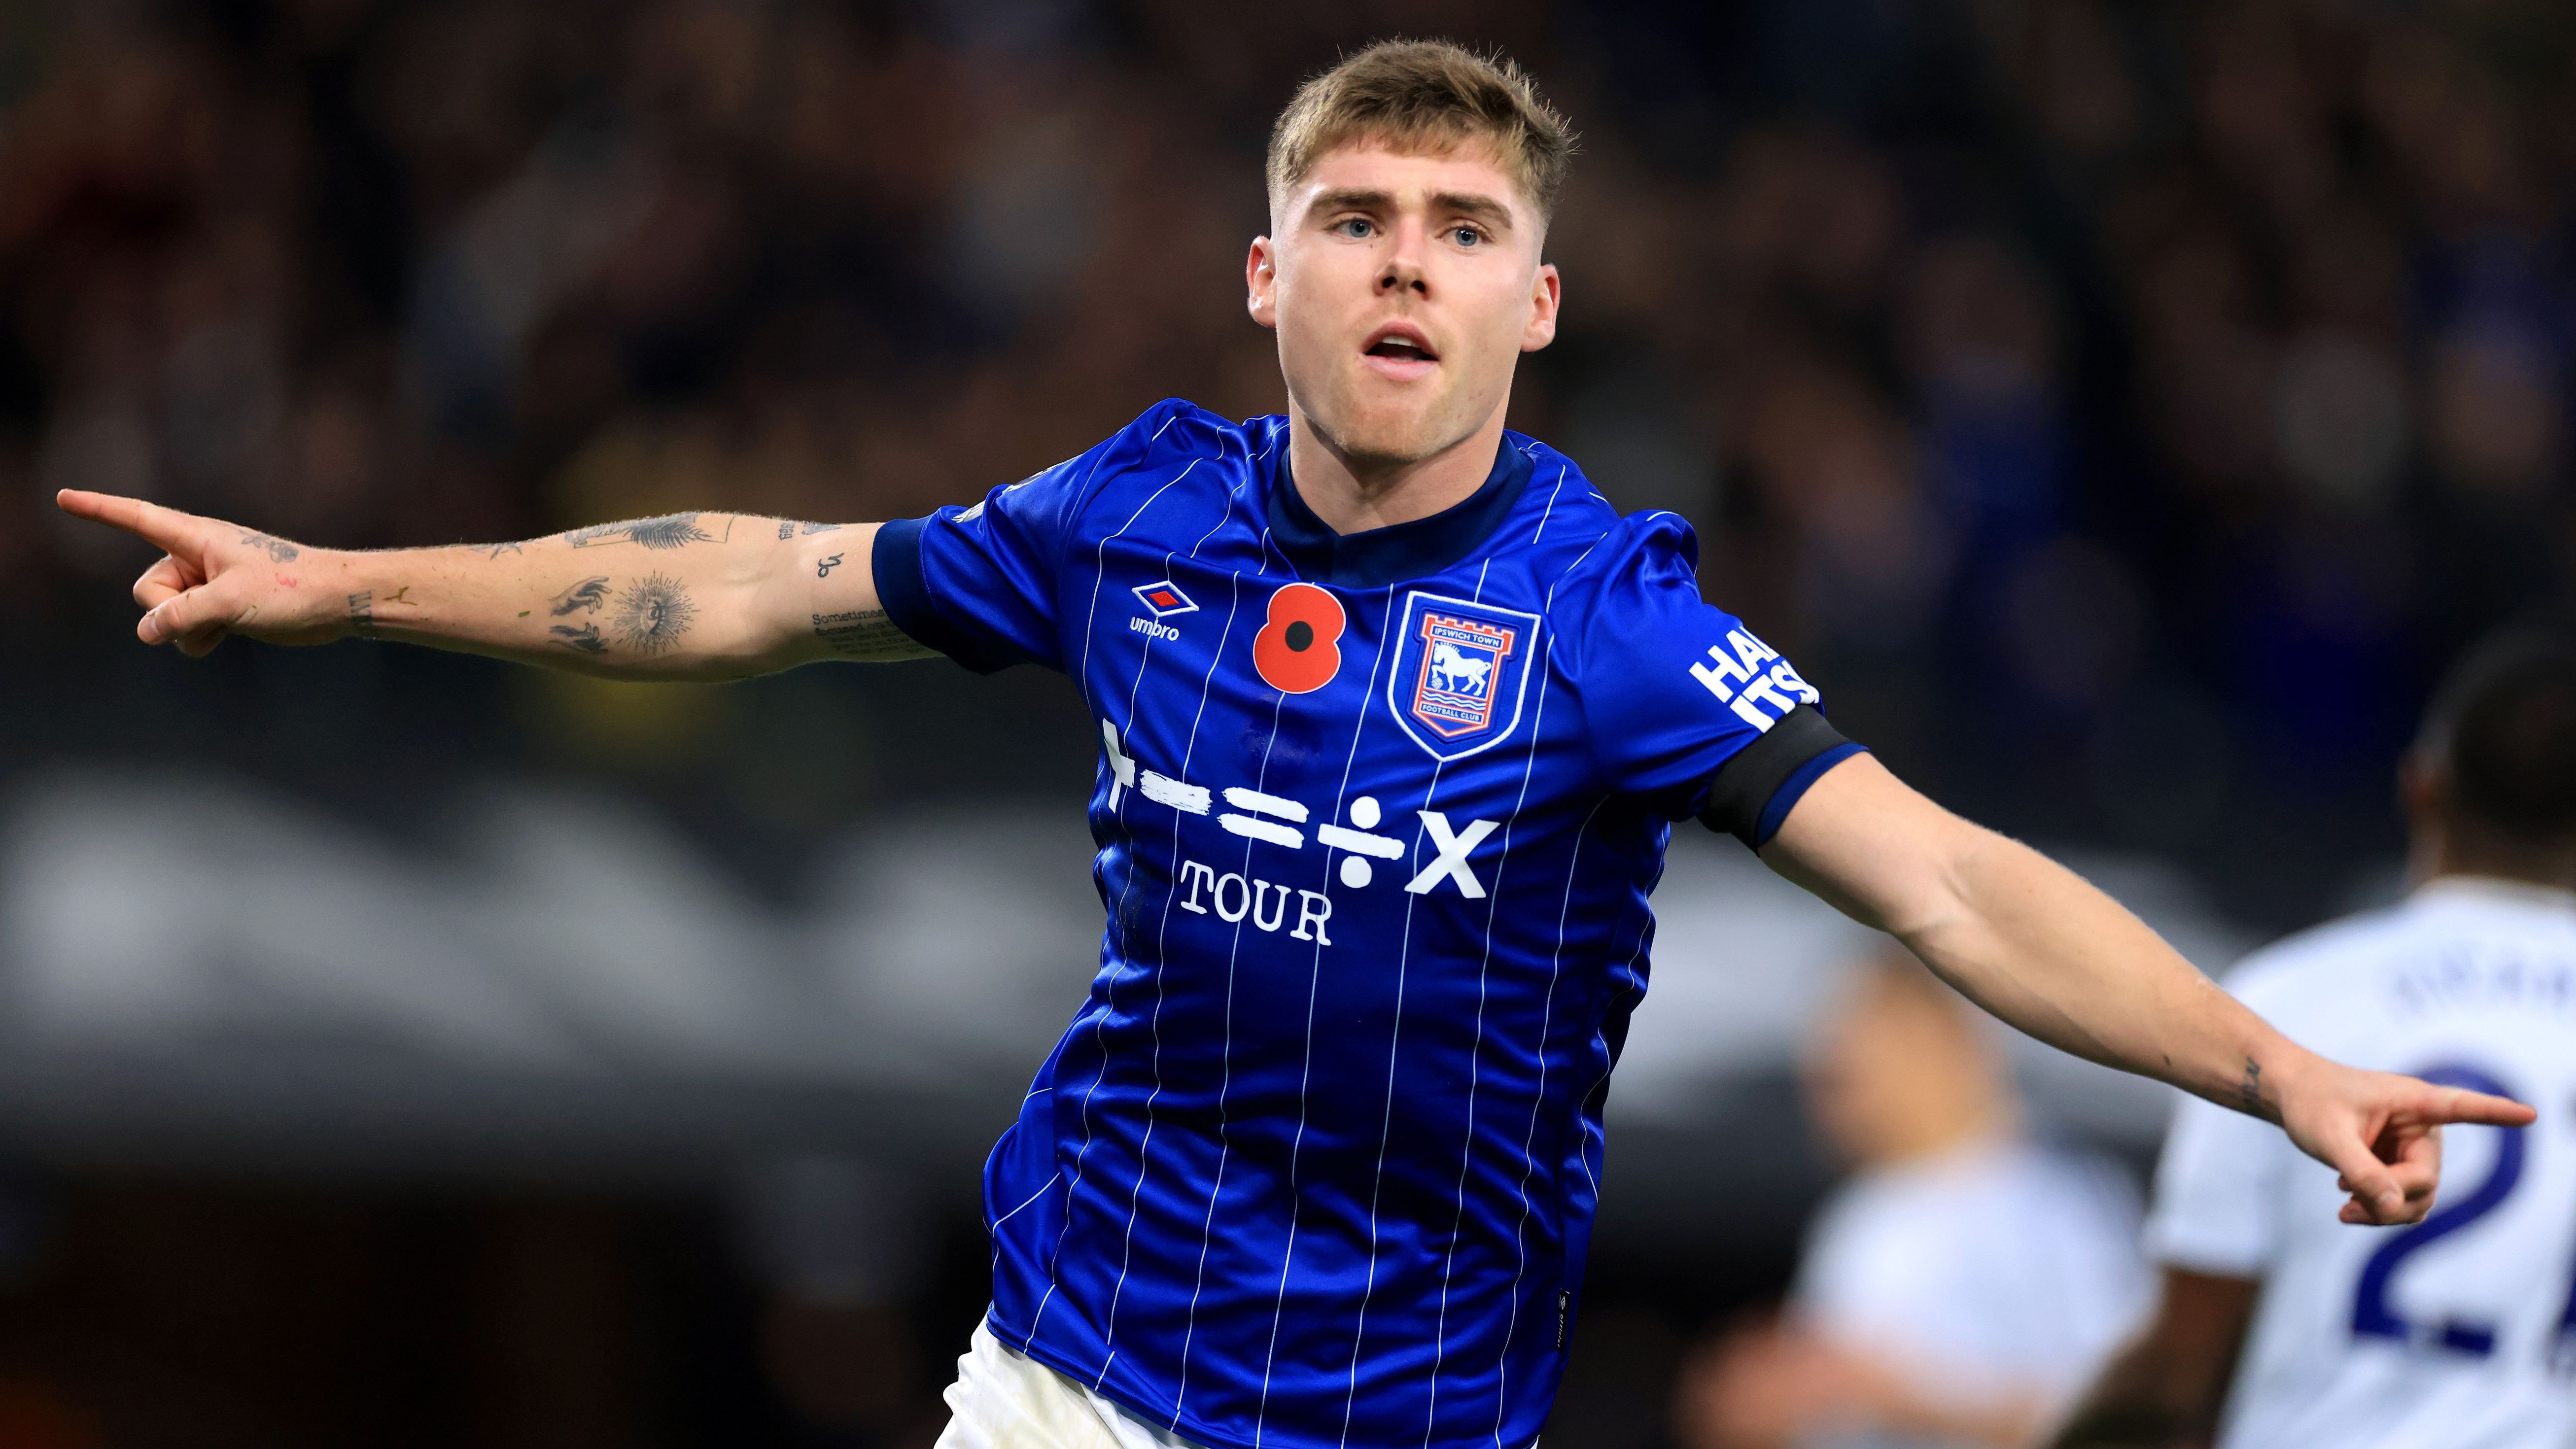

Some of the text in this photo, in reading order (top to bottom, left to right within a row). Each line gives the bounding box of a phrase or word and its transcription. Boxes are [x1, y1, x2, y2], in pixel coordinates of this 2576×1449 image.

[812, 609, 884, 625] Sometimes
[1130, 617, 1179, 641] umbro
[1434, 627, 1499, 647] IPSWICH TOWN
[1422, 704, 1480, 722] FOOTBALL CLUB
[1181, 860, 1332, 946] TOUR
